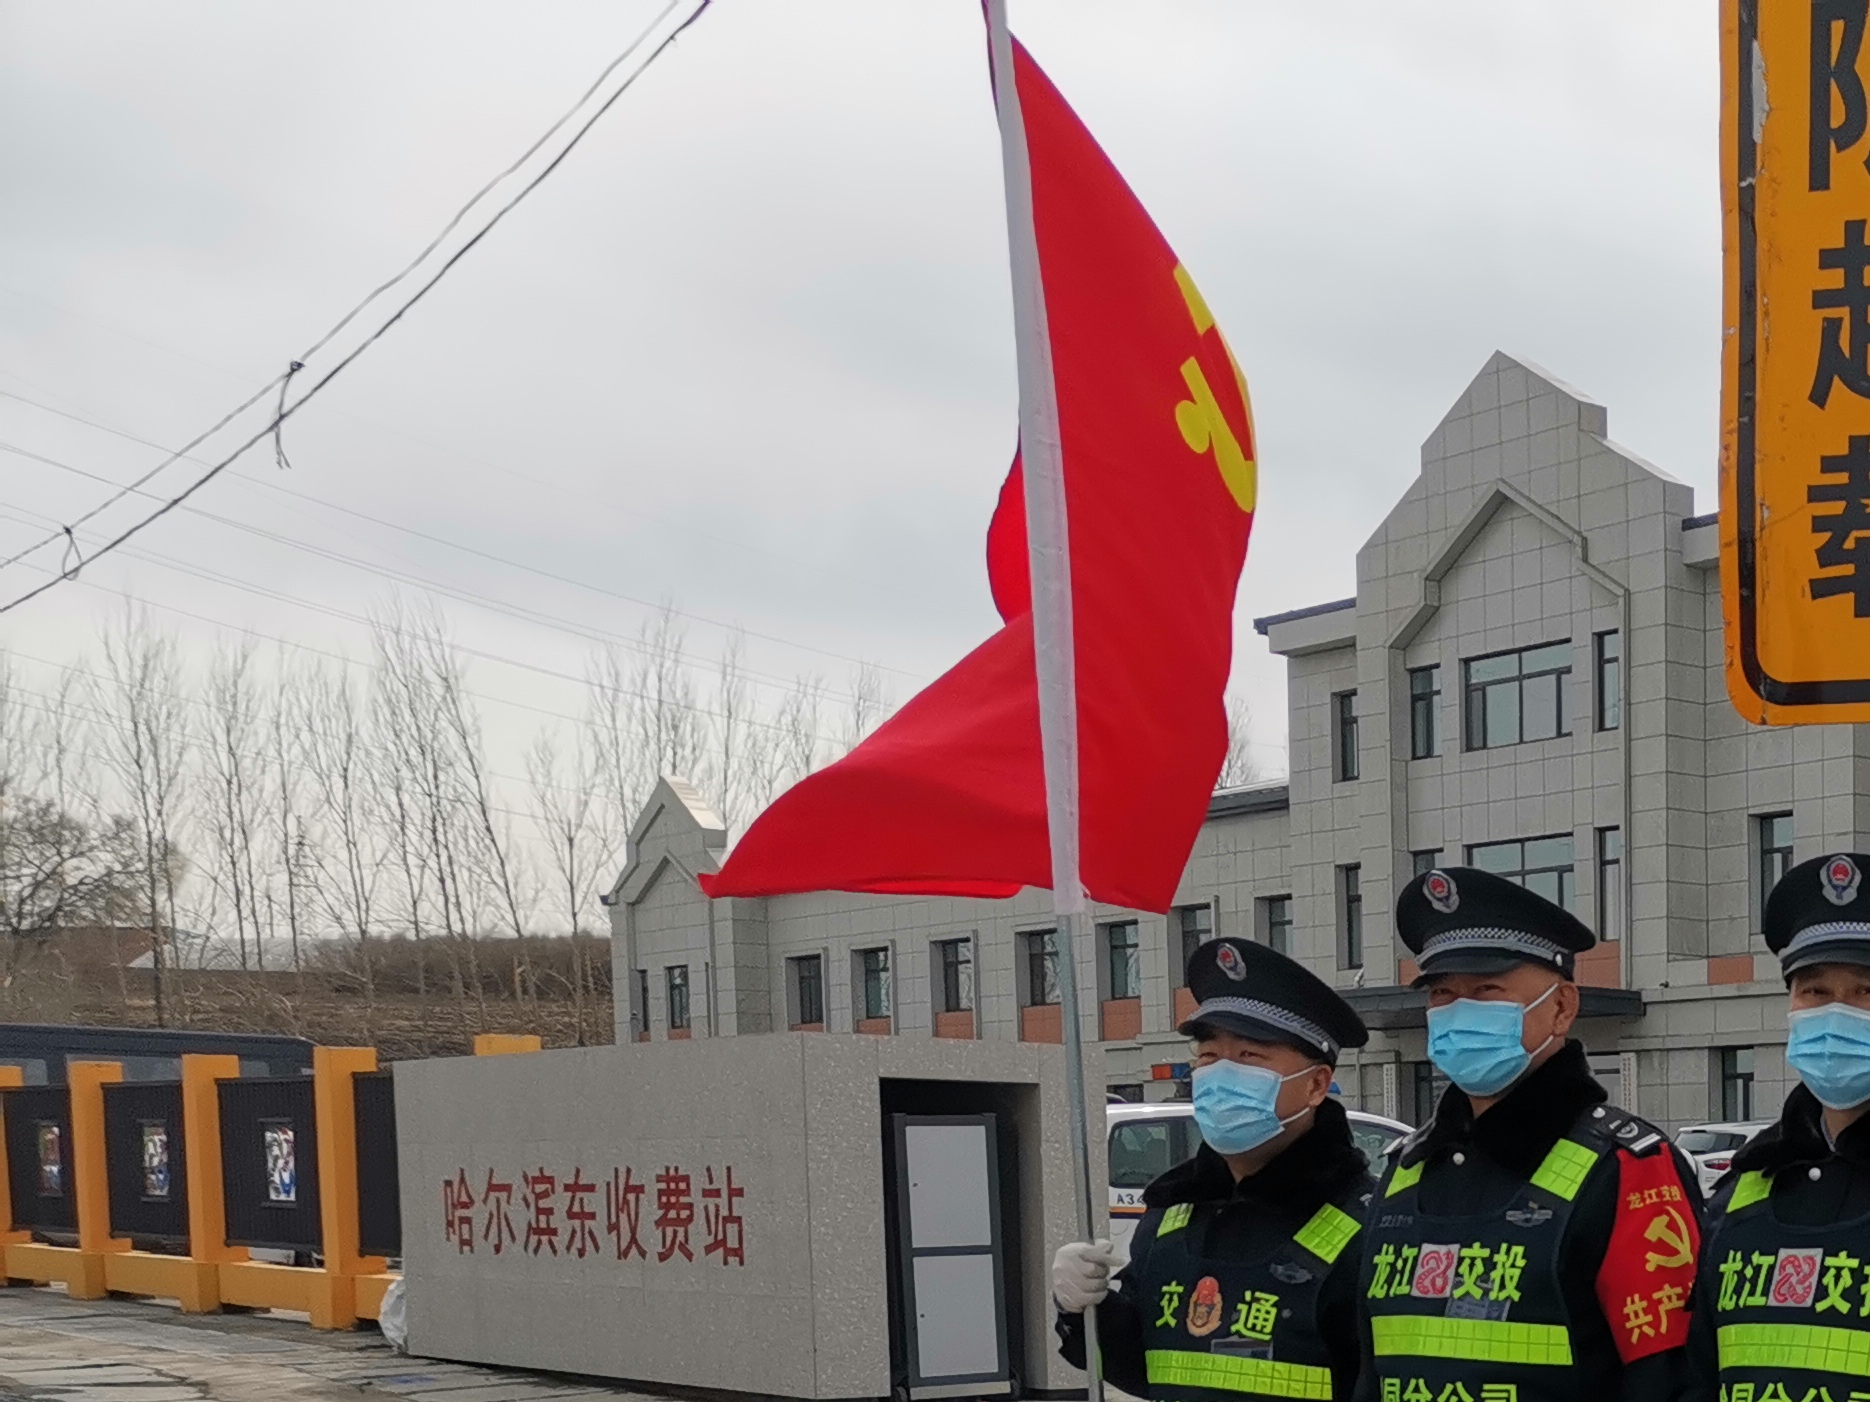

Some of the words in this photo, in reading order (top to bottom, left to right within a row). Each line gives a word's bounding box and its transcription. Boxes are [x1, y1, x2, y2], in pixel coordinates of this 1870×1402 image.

[443, 1164, 746, 1267] 哈尔滨东收费站
[1367, 1243, 1419, 1299] 龙江
[1452, 1241, 1528, 1302] 交投
[1717, 1250, 1776, 1312] 龙江
[1155, 1280, 1185, 1328] 交
[1230, 1290, 1280, 1341] 通
[1623, 1279, 1695, 1344] 共产
